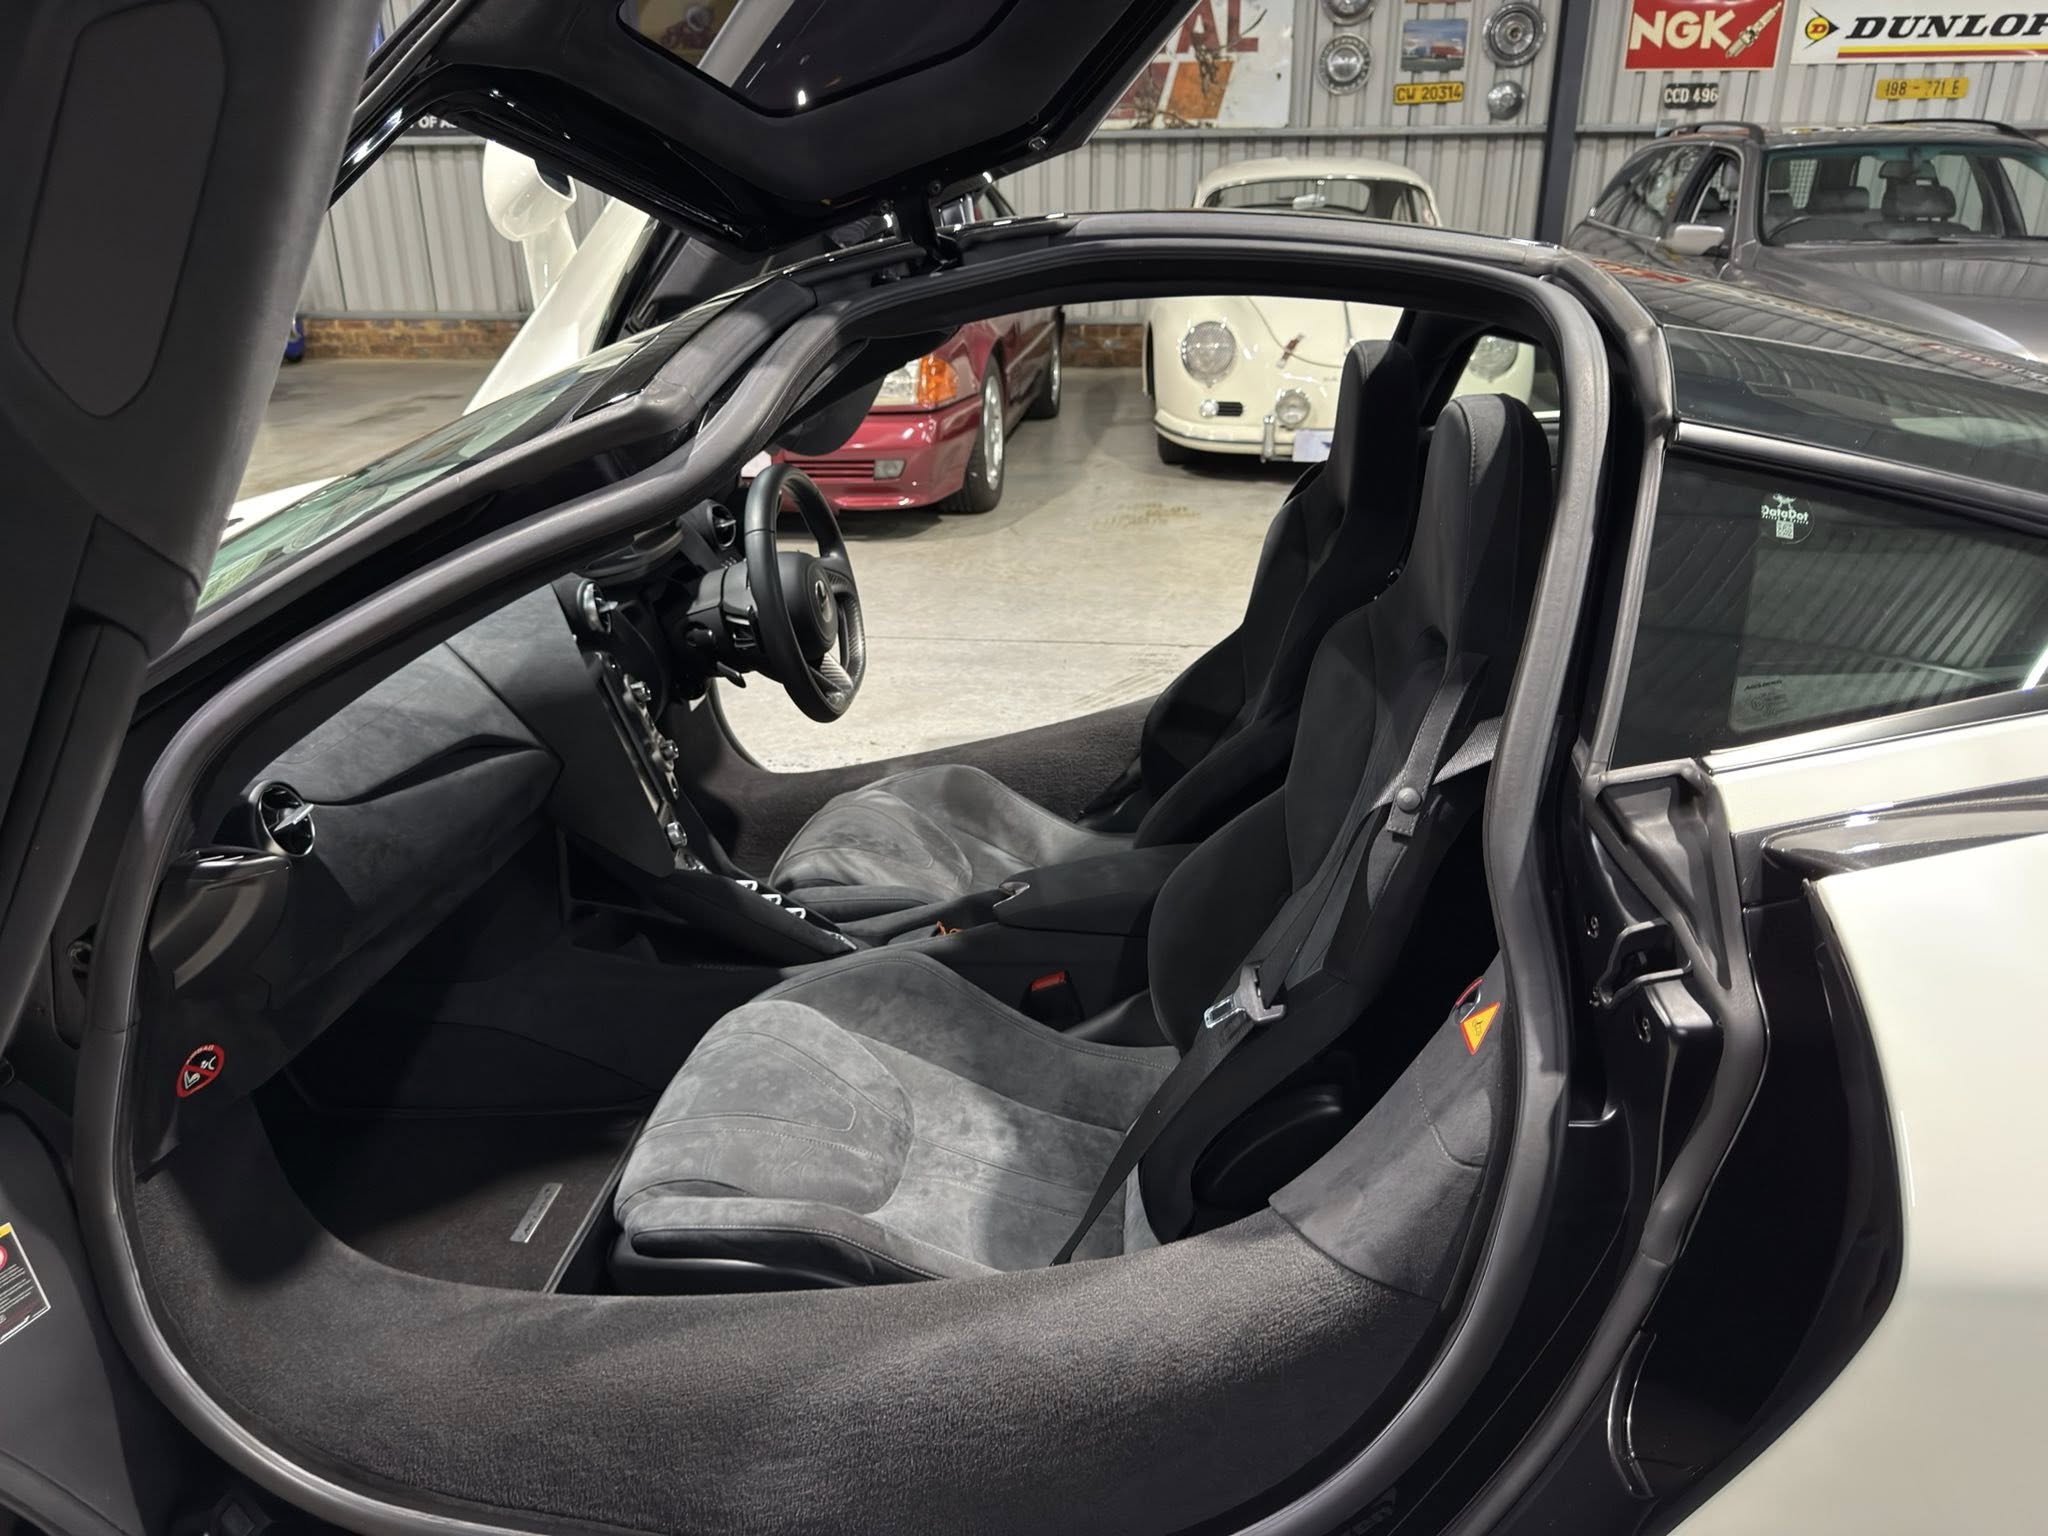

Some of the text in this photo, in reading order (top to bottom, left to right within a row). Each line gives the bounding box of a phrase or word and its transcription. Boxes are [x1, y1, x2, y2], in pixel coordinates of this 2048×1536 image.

[1159, 0, 1259, 53] AL
[1629, 9, 1736, 50] NGK
[1421, 85, 1462, 101] 20314
[1663, 87, 1719, 104] CCD 496
